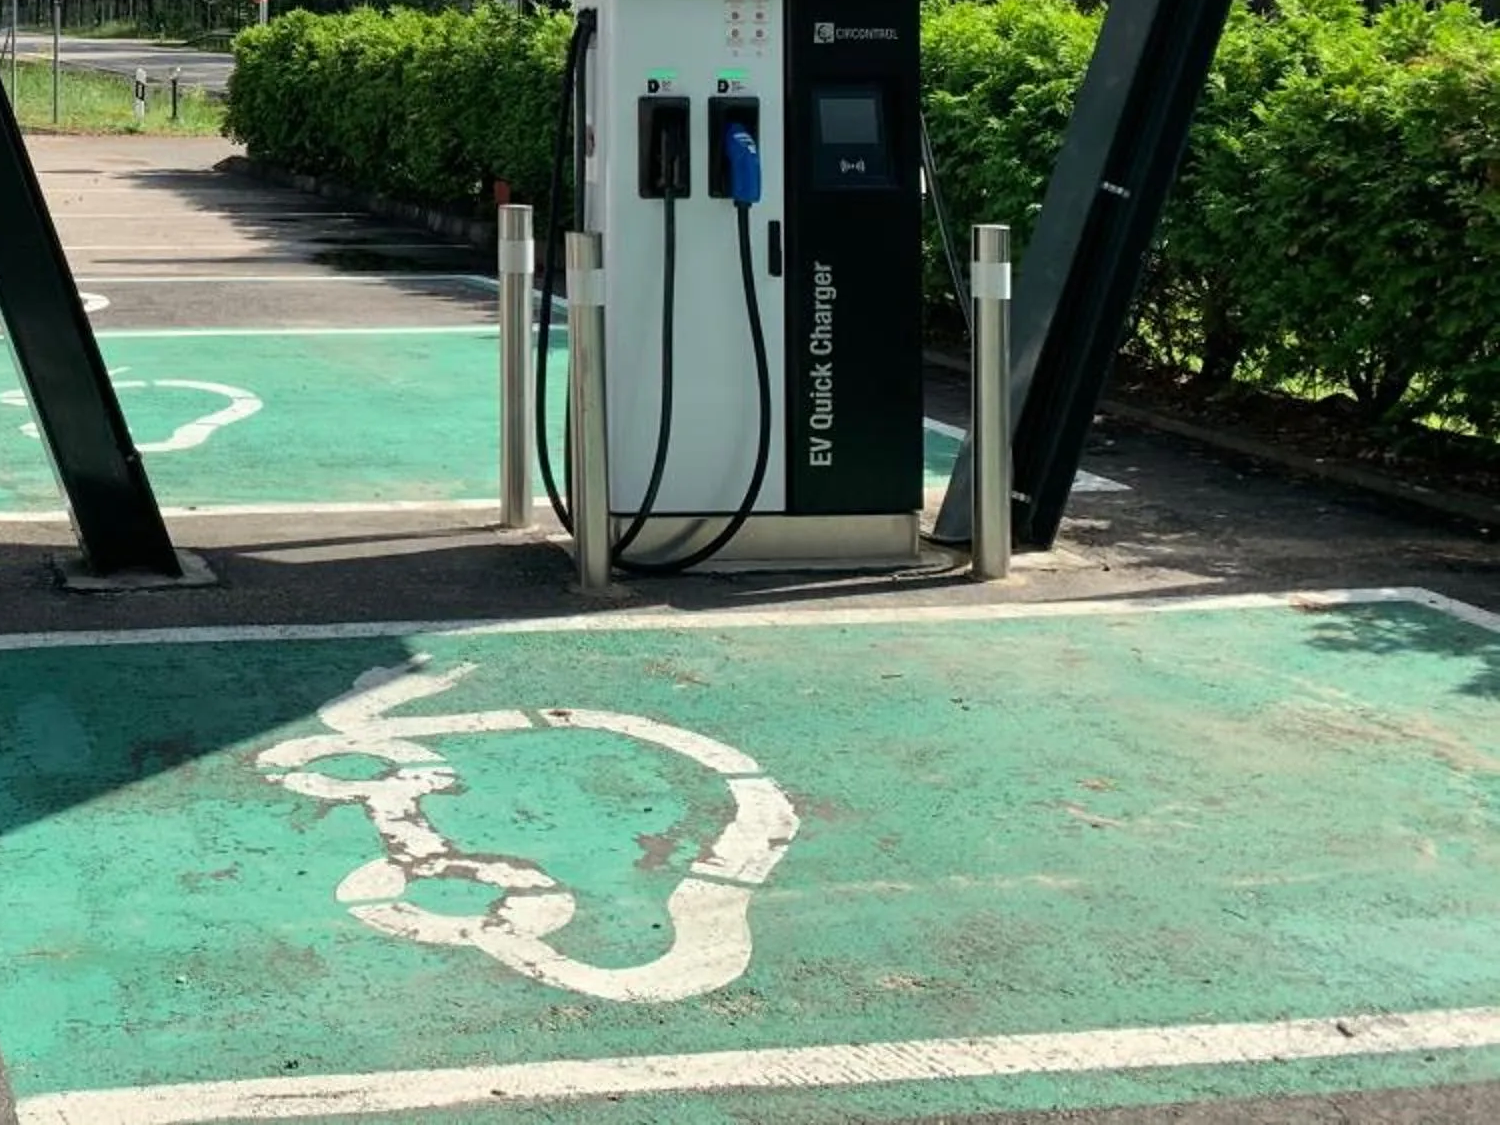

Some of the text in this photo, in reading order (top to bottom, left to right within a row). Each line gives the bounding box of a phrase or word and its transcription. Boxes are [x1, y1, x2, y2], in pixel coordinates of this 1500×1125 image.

[809, 260, 837, 467] EV Quick Charger
